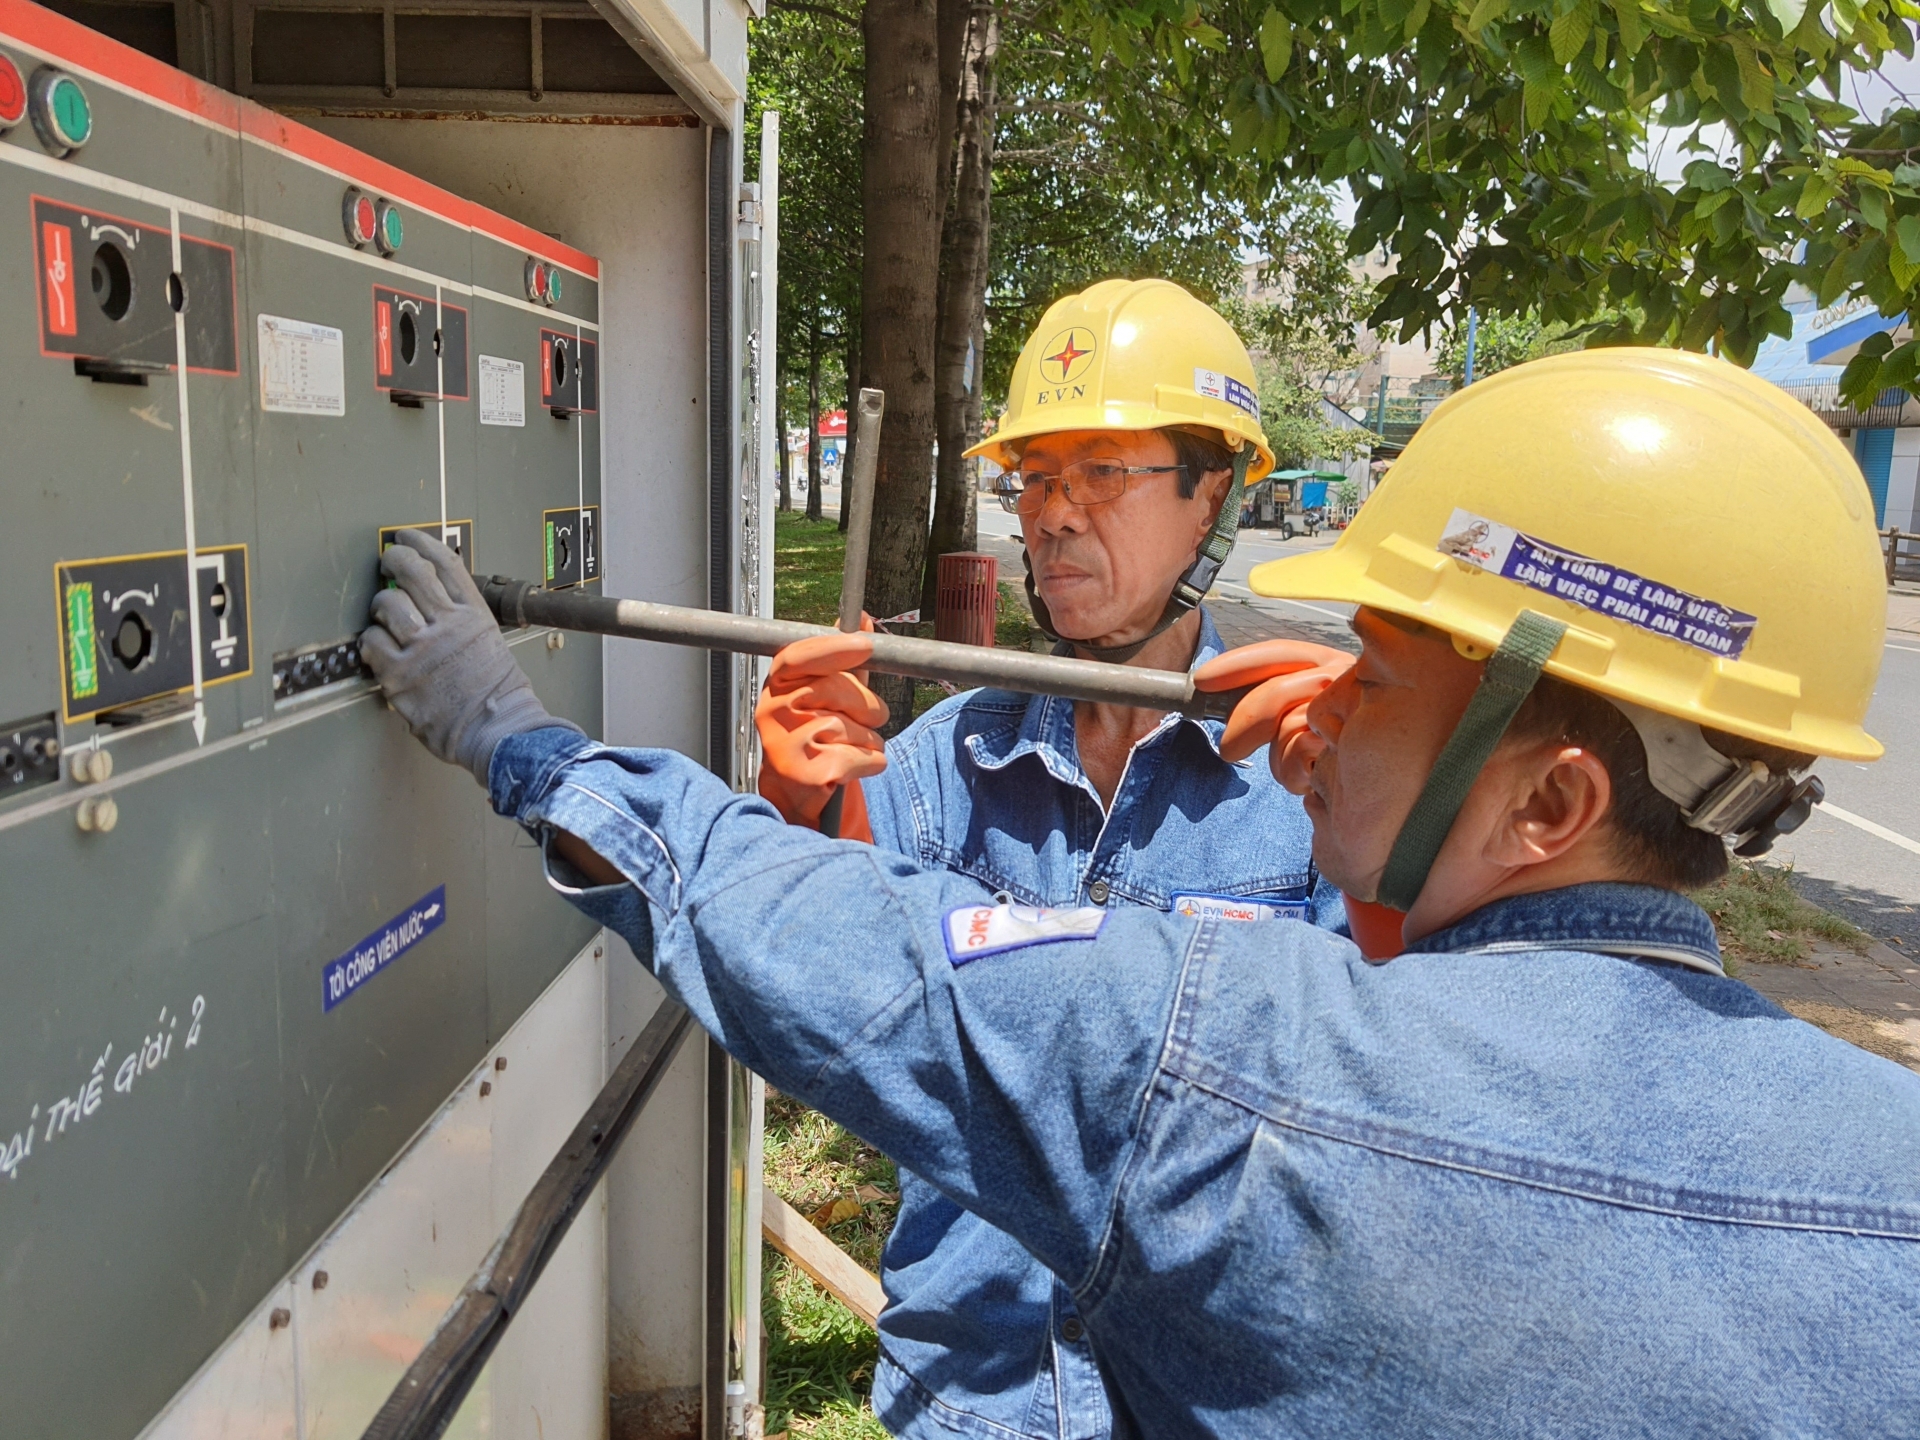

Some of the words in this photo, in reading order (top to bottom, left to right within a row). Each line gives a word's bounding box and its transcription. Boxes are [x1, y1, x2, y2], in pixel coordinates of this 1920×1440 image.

[1036, 384, 1086, 406] EVN
[1514, 563, 1554, 588] LÀM
[1556, 578, 1600, 605] VIỆC
[1602, 594, 1650, 623] PHẢI
[1650, 613, 1680, 633] AN
[1683, 622, 1733, 652] TOÀN
[1612, 573, 1643, 596] ĐỂ
[1642, 586, 1684, 611] LÀM
[1203, 906, 1255, 920] EVNHCMC
[346, 951, 376, 988] CÔNG
[376, 929, 399, 965] VIÊN
[399, 910, 424, 949] NƯỚC
[45, 1041, 113, 1142] THẾ
[185, 994, 206, 1049] 2
